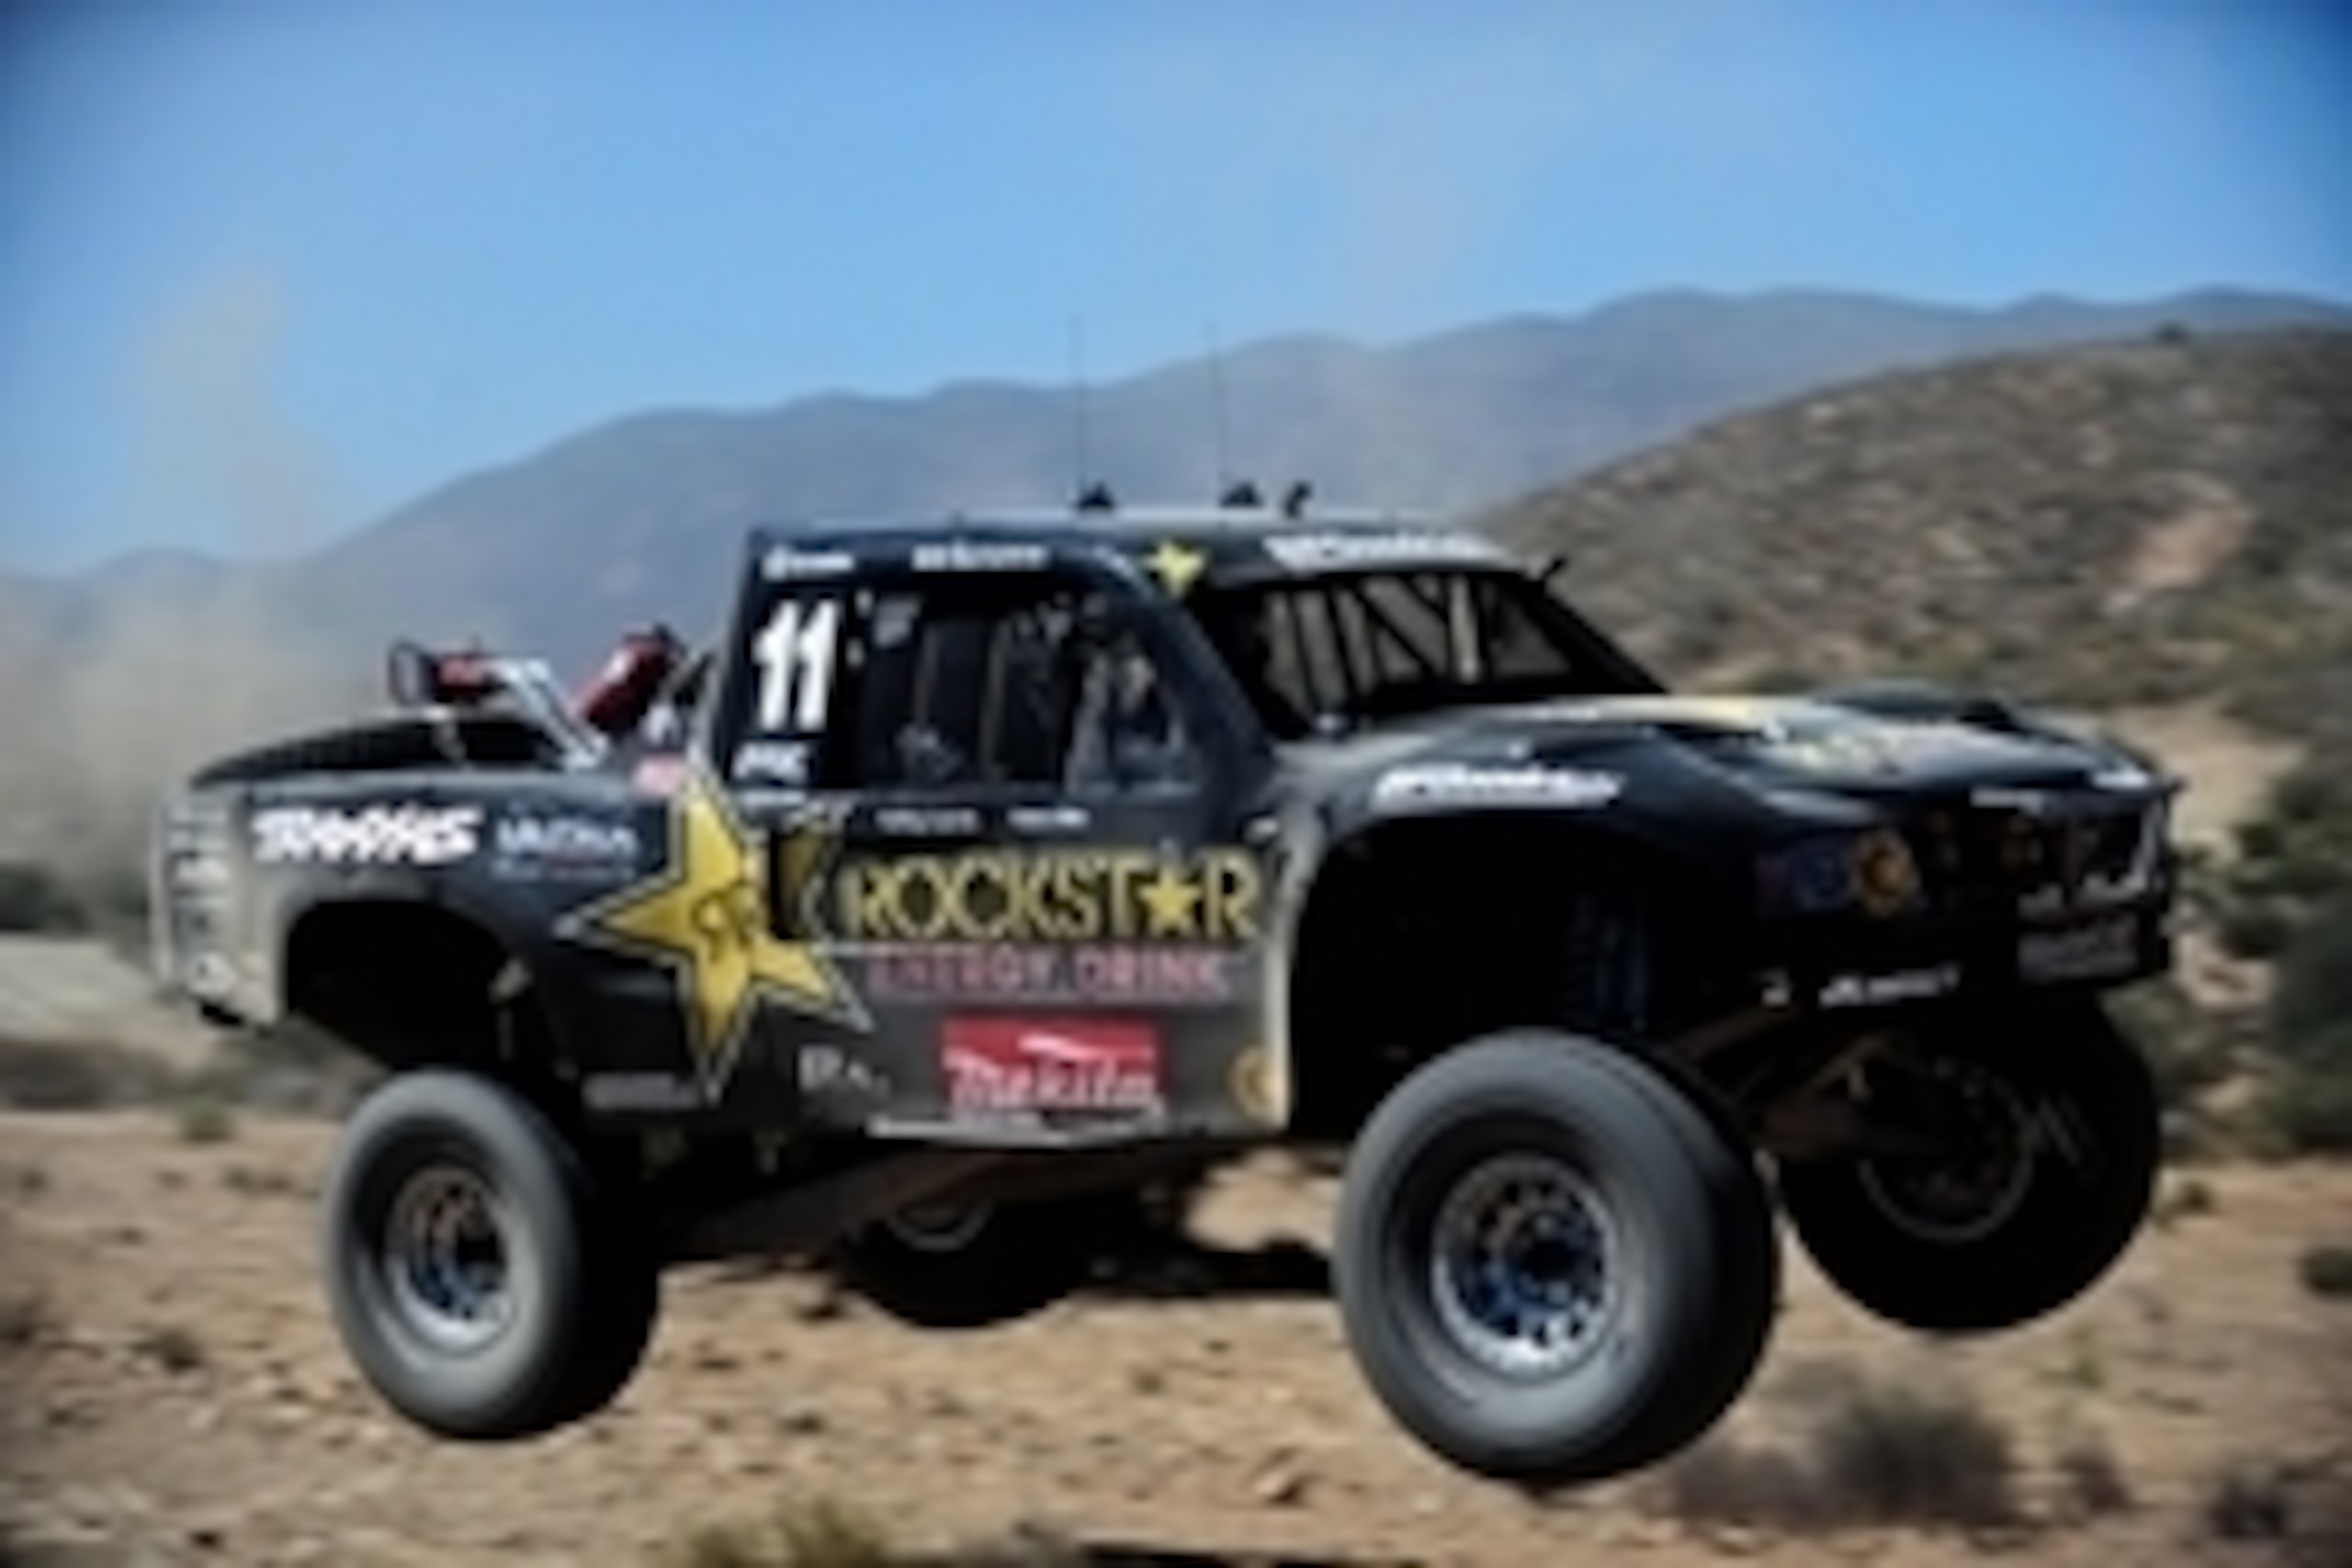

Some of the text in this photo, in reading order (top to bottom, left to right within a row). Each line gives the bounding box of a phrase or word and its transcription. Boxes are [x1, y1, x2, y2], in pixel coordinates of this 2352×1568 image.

[751, 597, 840, 731] 11
[868, 948, 1230, 998] ENERGY DRINK
